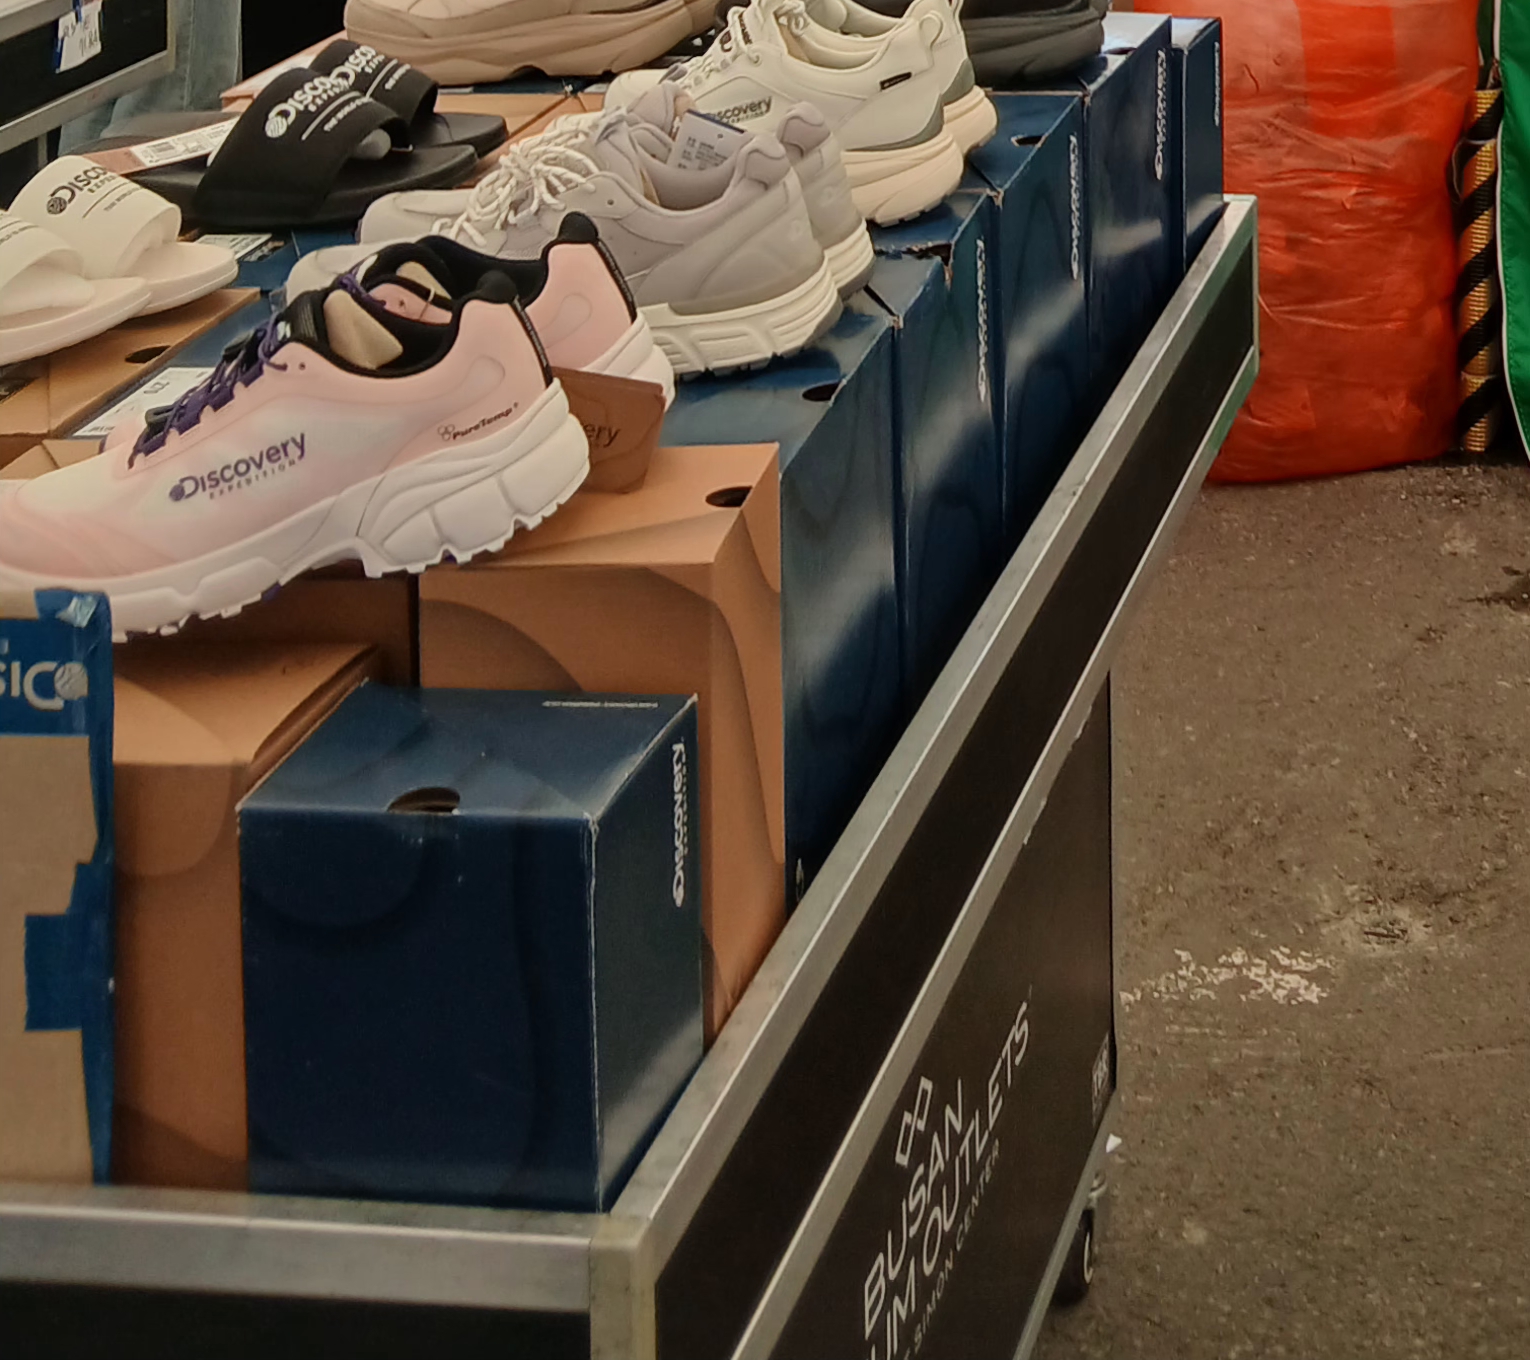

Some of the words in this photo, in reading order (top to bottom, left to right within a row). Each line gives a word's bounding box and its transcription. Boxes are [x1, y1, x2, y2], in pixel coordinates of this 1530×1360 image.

[169, 432, 305, 502] Discovery
[864, 1078, 963, 1341] BUSAN
[922, 1001, 1029, 1277] OUTLETS
